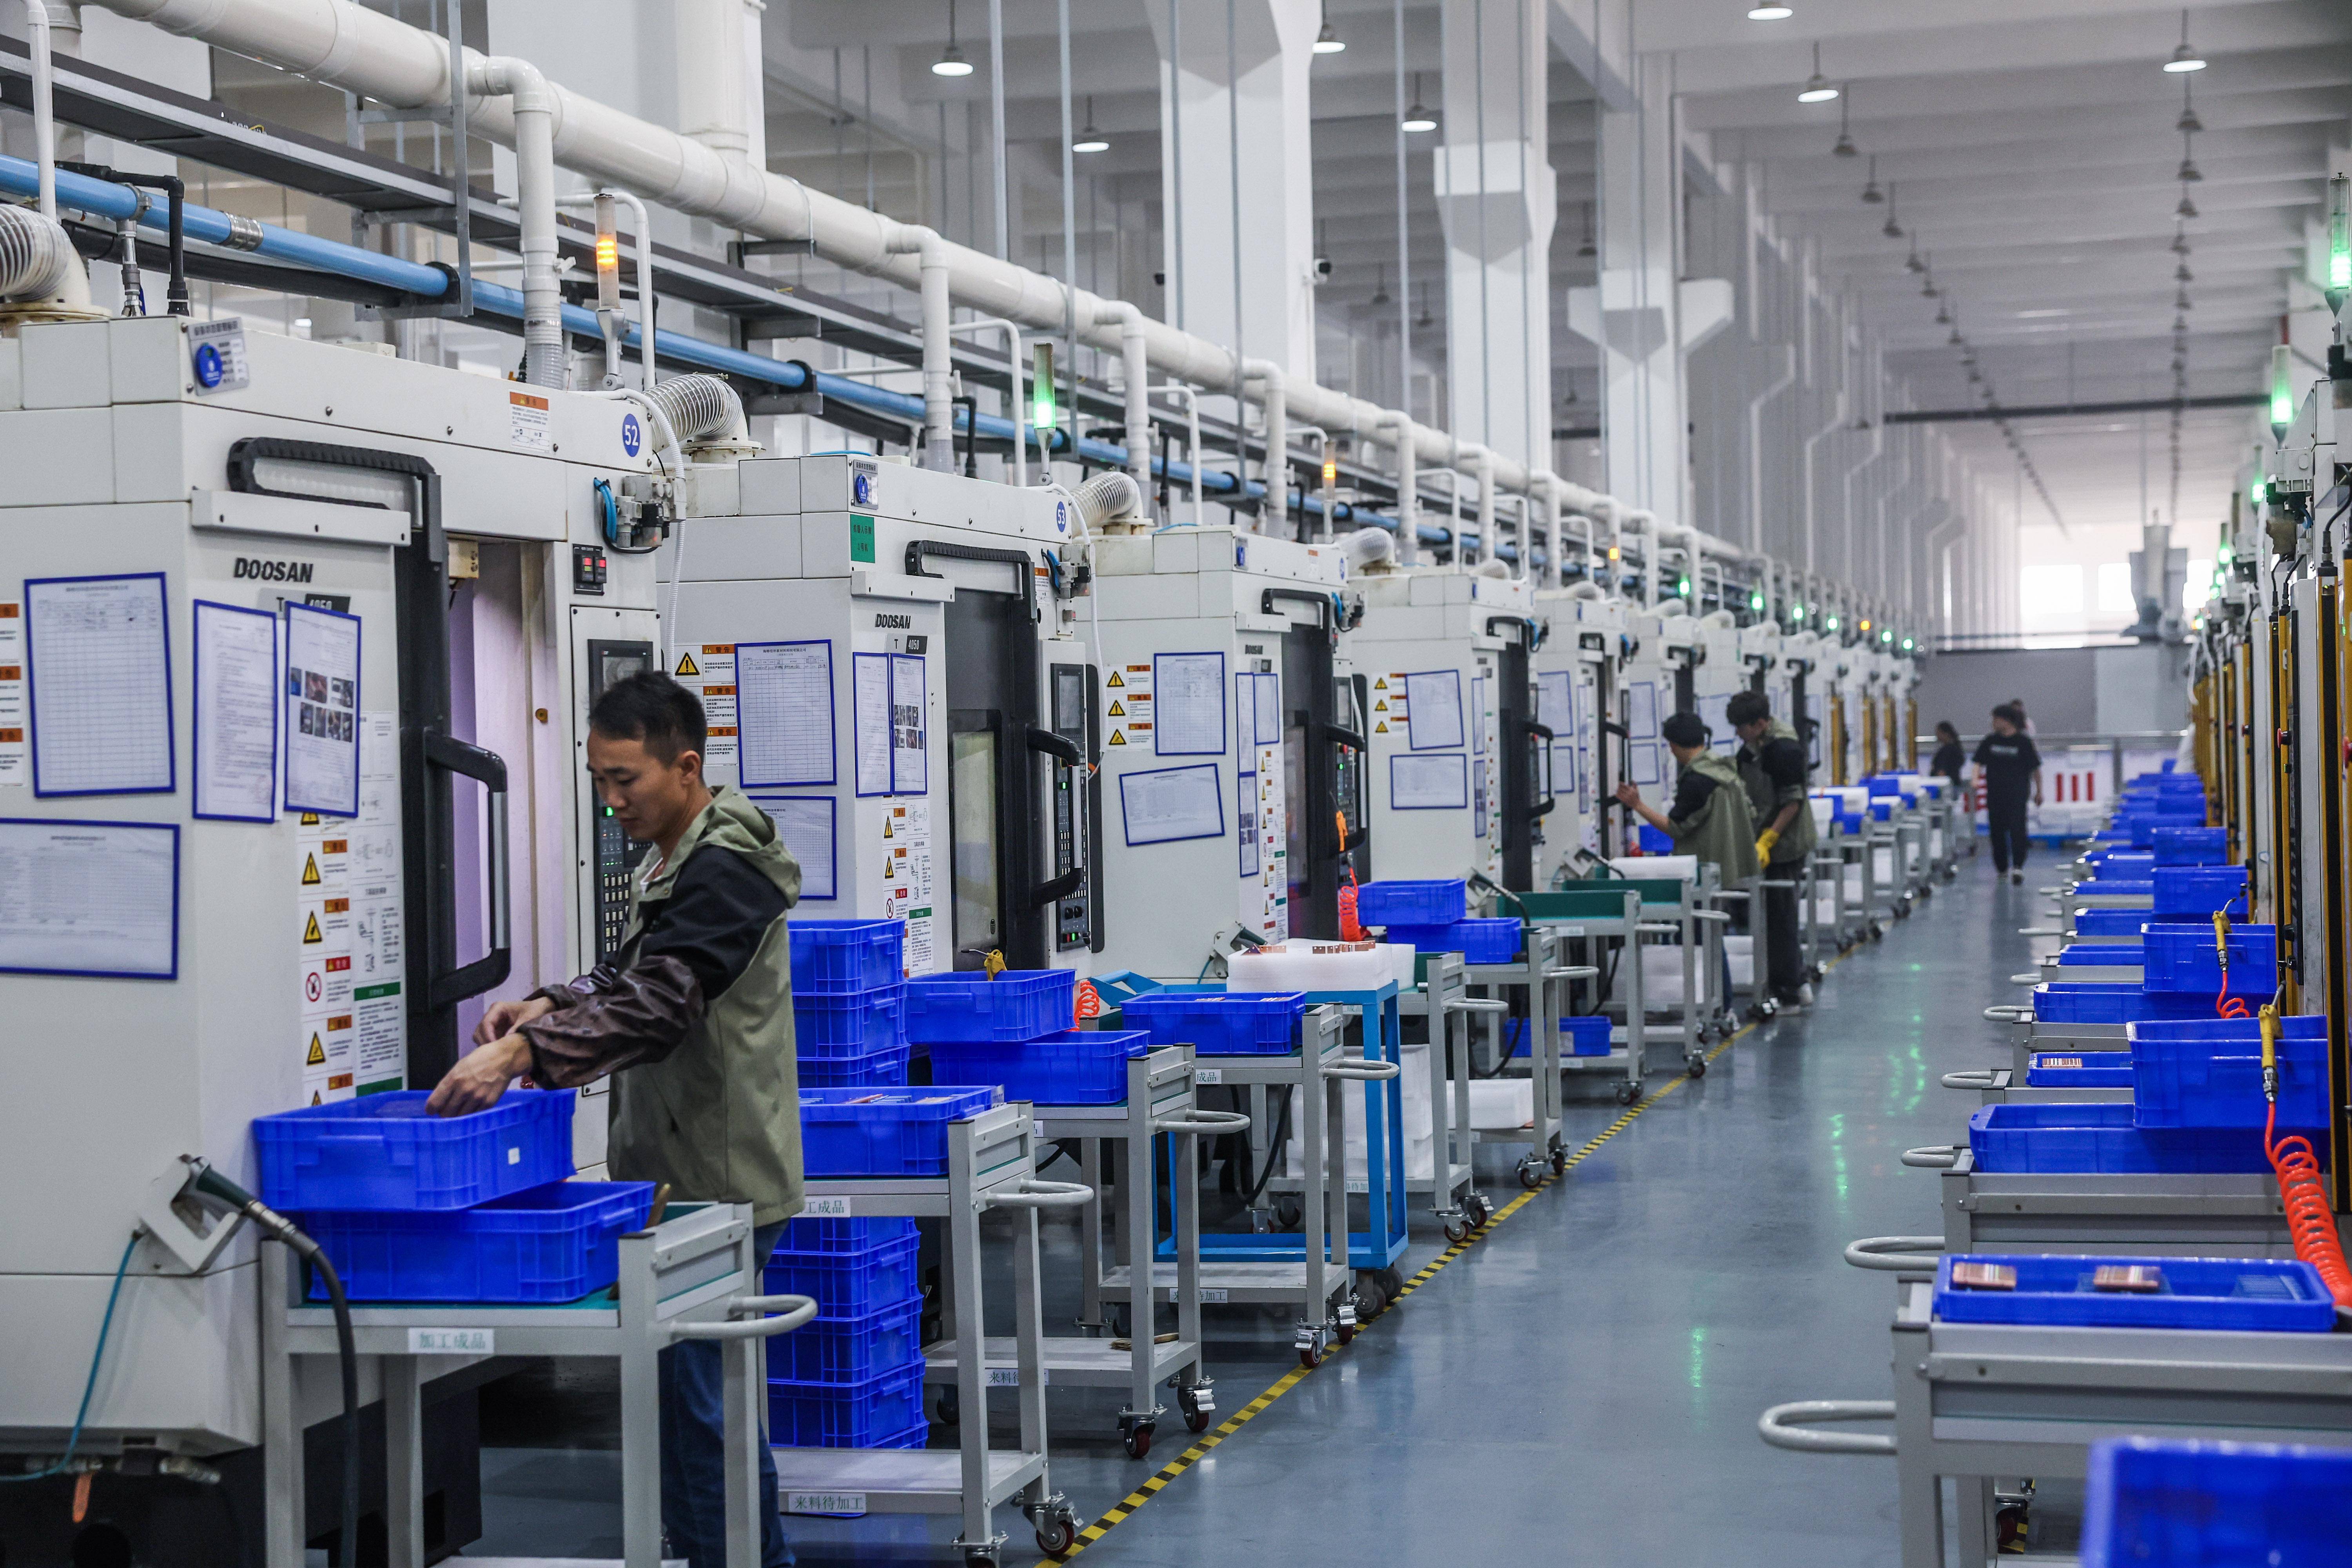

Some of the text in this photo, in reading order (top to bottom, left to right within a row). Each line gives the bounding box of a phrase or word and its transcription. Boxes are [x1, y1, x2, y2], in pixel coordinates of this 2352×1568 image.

[624, 424, 639, 446] 52
[1058, 509, 1065, 525] 53
[234, 557, 314, 583] DOOSAN
[875, 613, 911, 629] DOOSAN
[894, 639, 920, 650] T 4050
[1196, 1072, 1217, 1082] 成品
[805, 1200, 844, 1213] 工成品
[795, 1495, 864, 1510] 来料待加工
